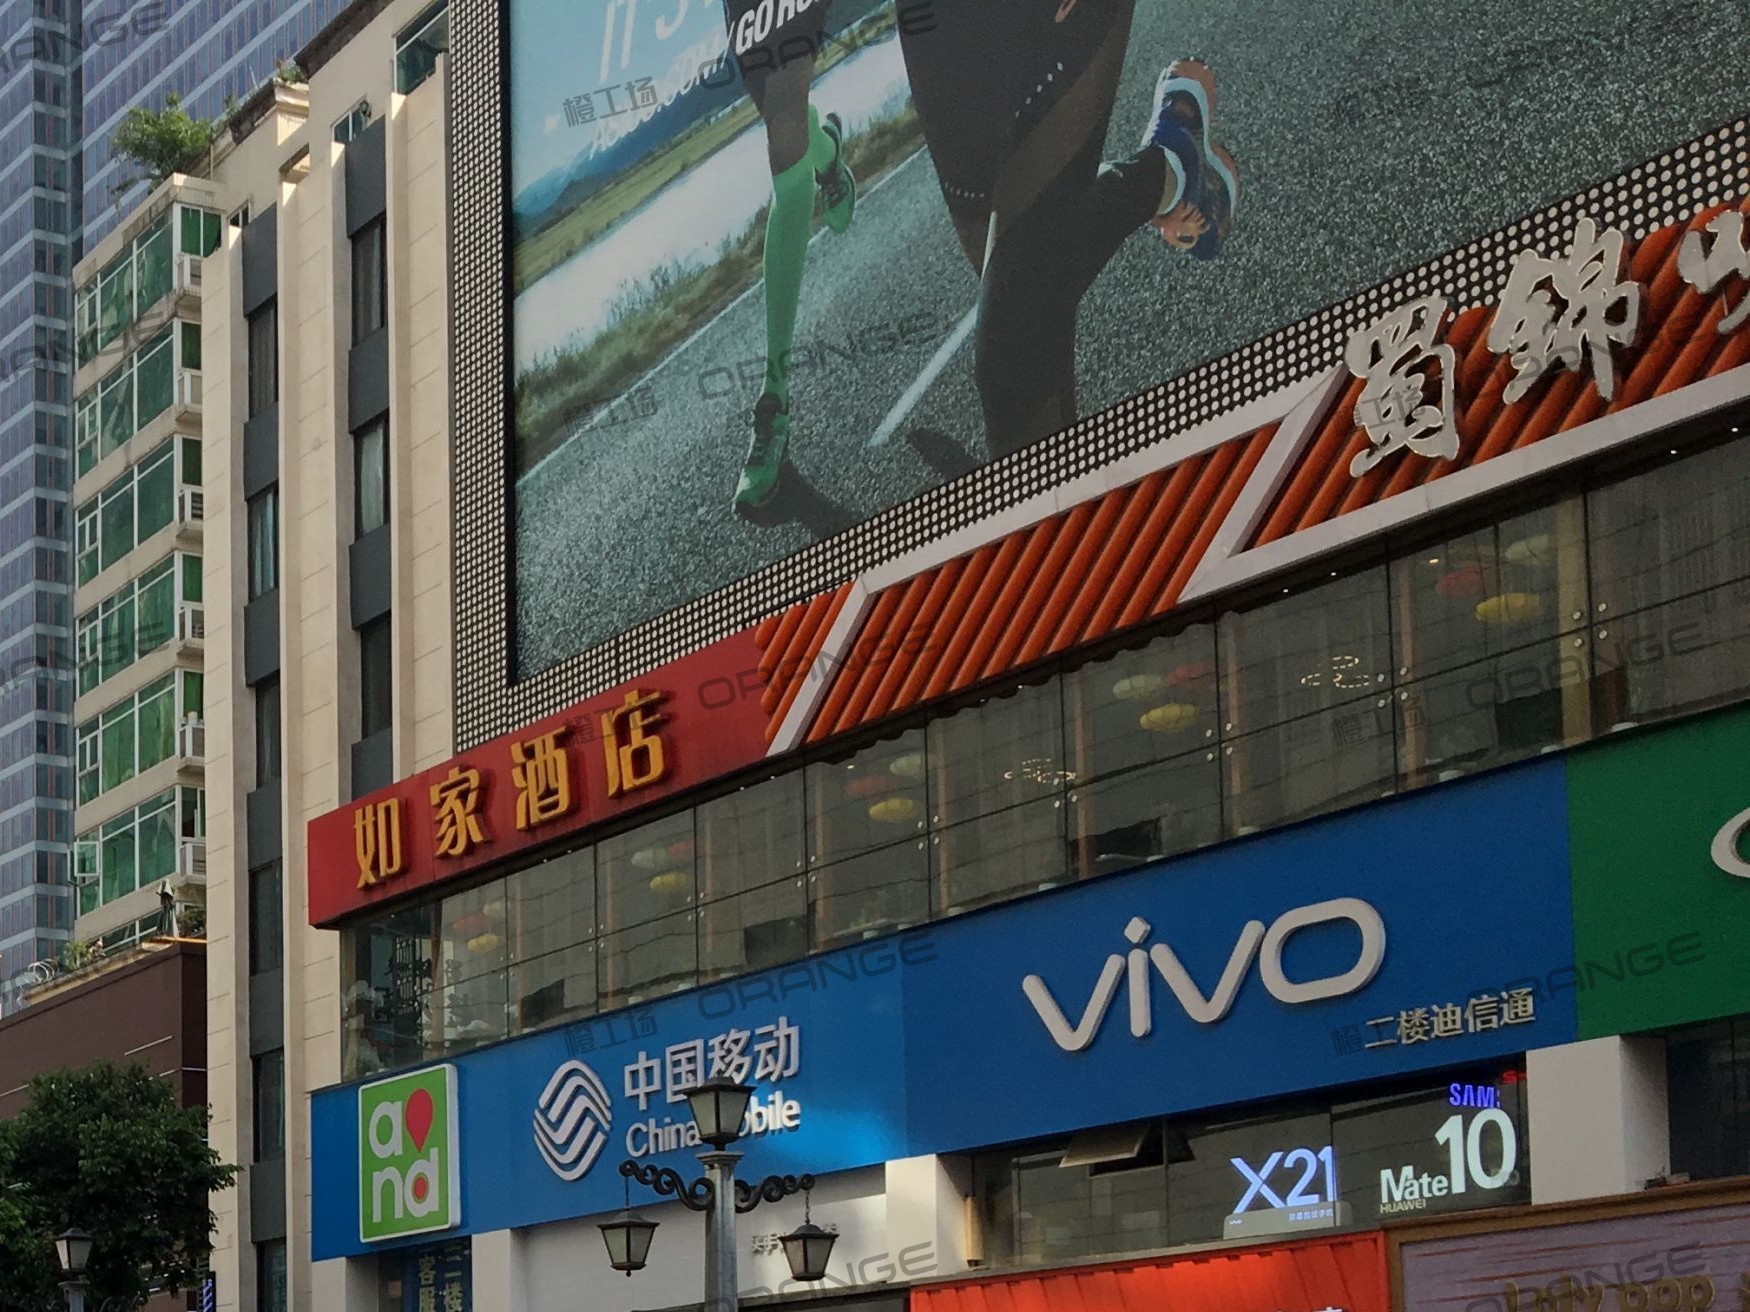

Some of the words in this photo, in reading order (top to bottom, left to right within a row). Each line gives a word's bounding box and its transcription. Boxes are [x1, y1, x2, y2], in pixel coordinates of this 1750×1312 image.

[354, 689, 669, 889] 如家酒店
[1023, 897, 1386, 1052] vivo
[1364, 988, 1535, 1050] 二楼迪信通
[624, 1016, 800, 1111] 中国移动
[626, 1117, 702, 1157] China
[1380, 1165, 1448, 1204] Mate
[1434, 1107, 1517, 1194] 10
[1230, 1145, 1337, 1214] X21
[1380, 1199, 1426, 1213] HUAWEI
